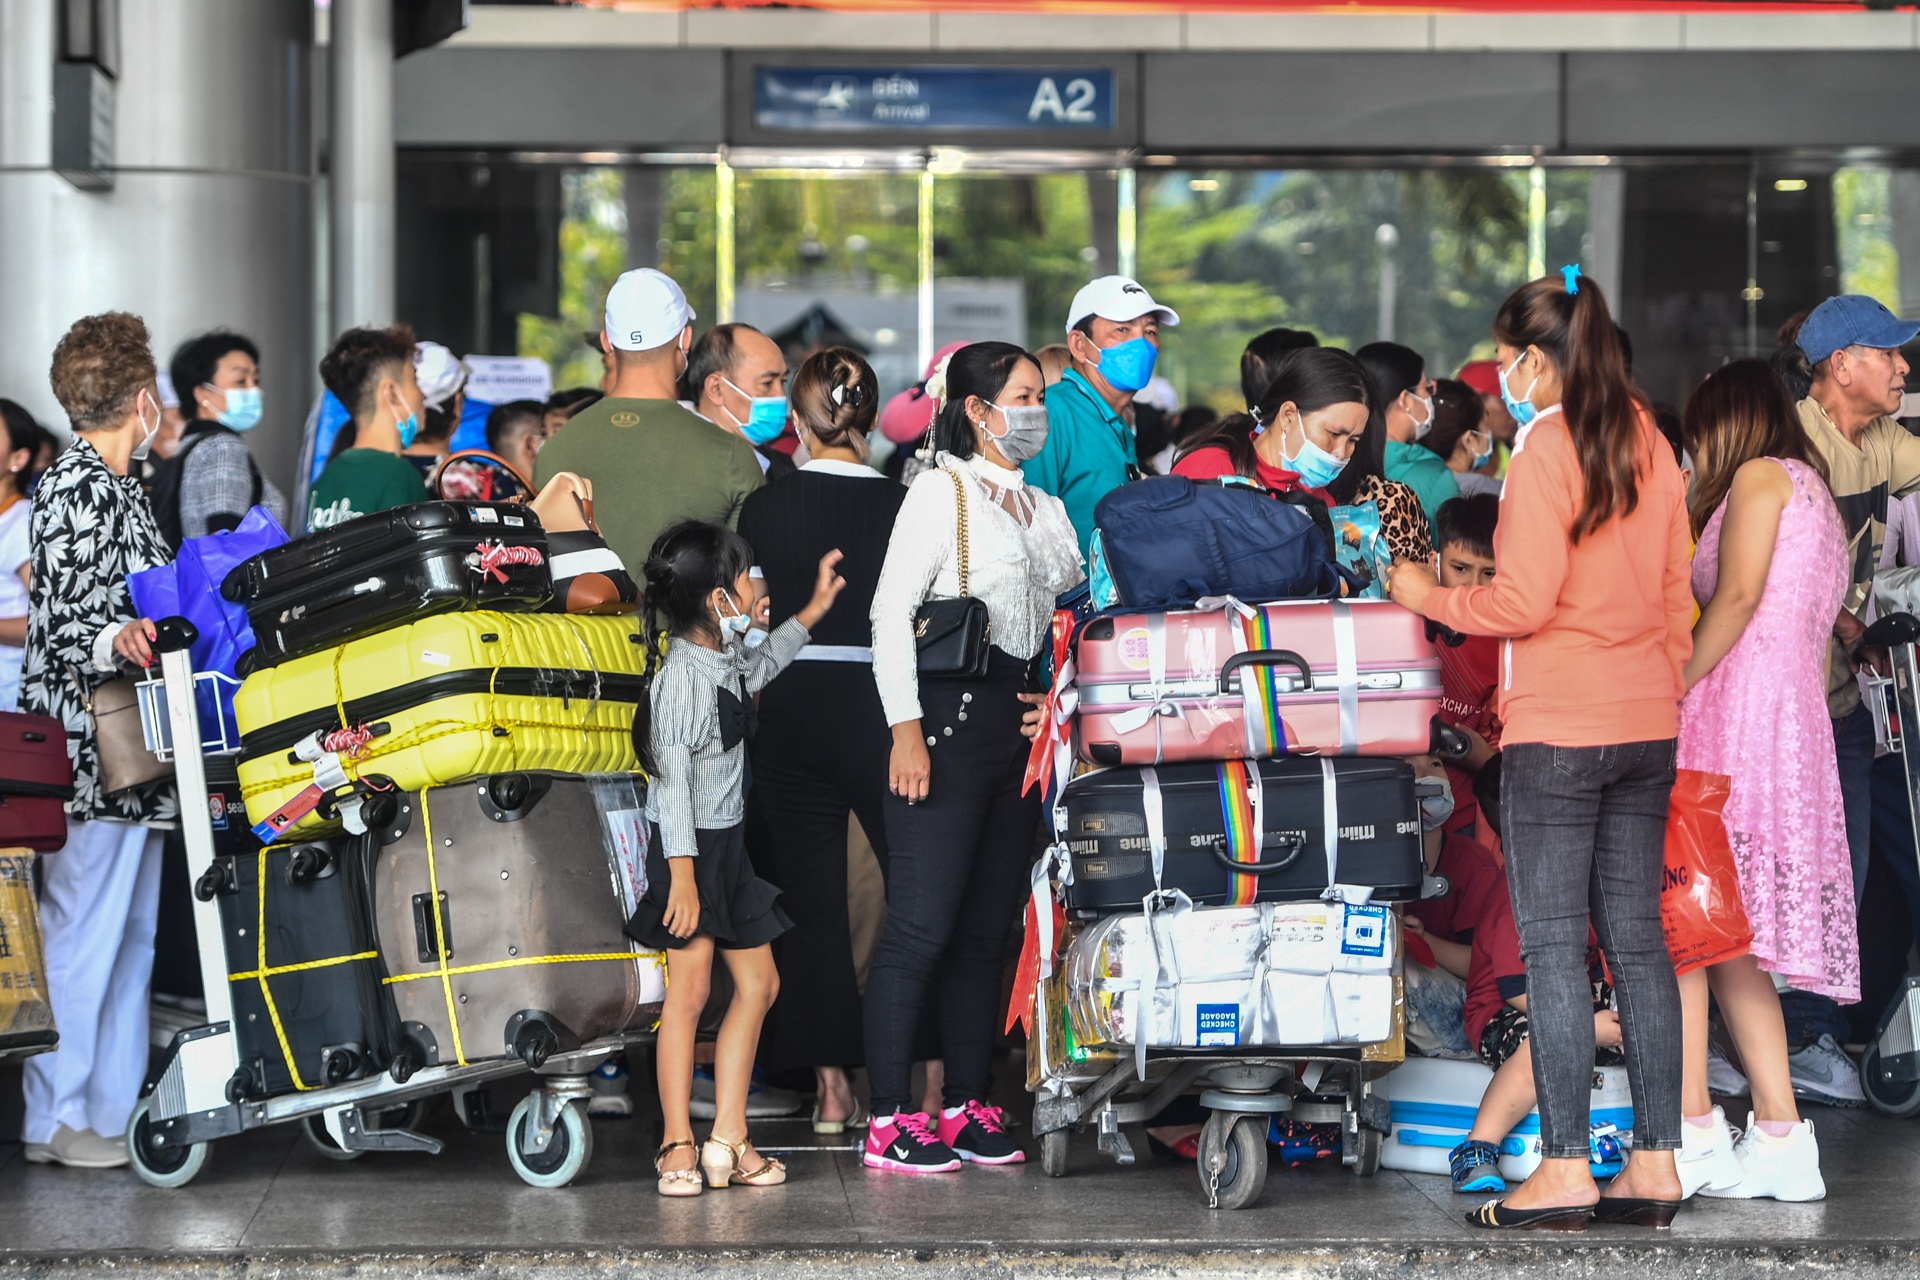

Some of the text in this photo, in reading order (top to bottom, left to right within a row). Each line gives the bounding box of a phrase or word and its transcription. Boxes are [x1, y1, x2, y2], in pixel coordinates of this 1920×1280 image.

[1028, 77, 1096, 122] A2
[1439, 696, 1481, 716] XCHAN
[1200, 1012, 1236, 1021] BAGGAGE
[1200, 1020, 1235, 1028] CHECKED
